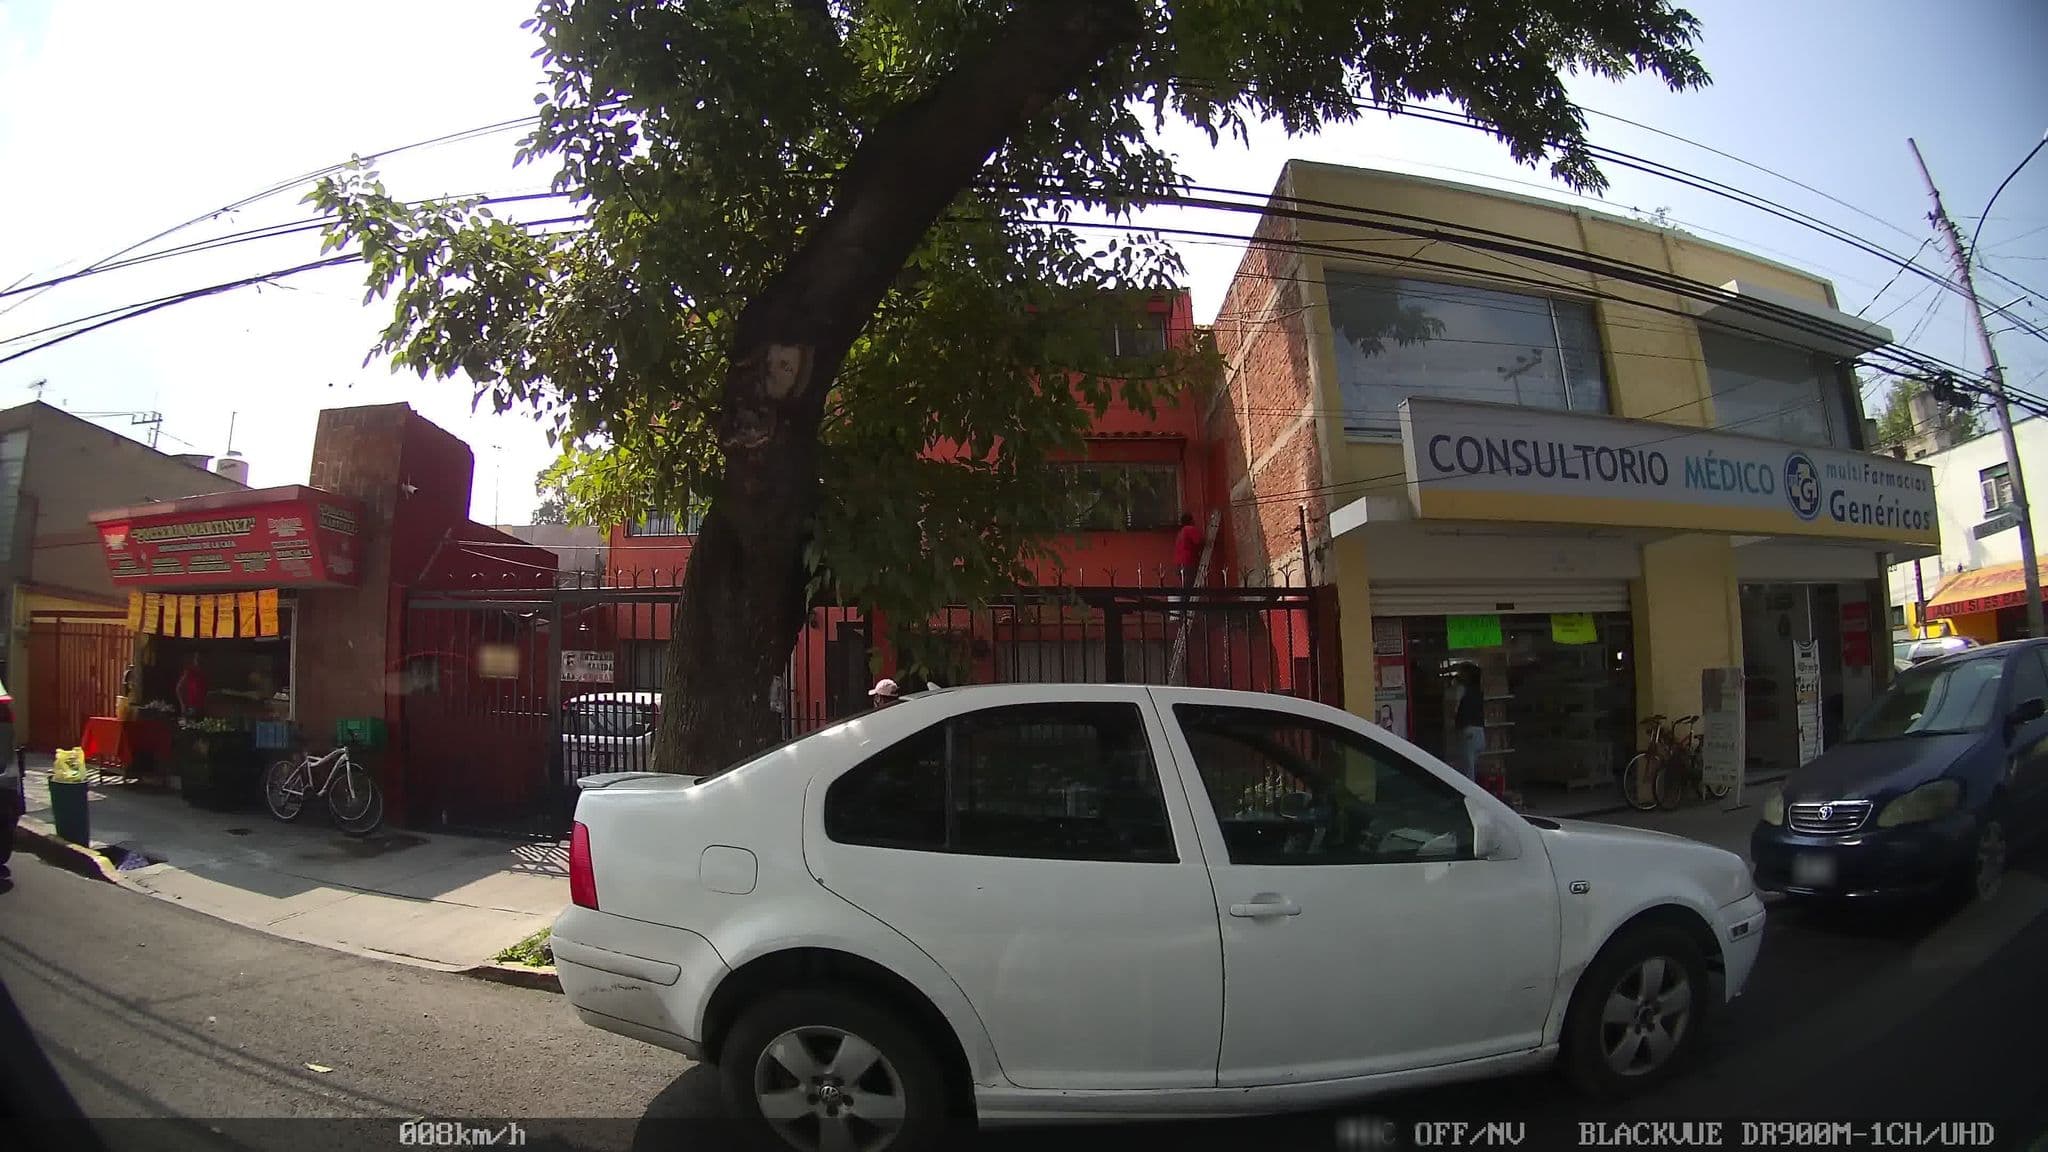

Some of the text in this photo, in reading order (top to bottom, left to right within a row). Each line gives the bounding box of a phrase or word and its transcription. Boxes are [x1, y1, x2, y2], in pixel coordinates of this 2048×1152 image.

[1429, 434, 1776, 495] CONSULTORIO MÉDICO
[1829, 489, 1931, 531] Genéricos
